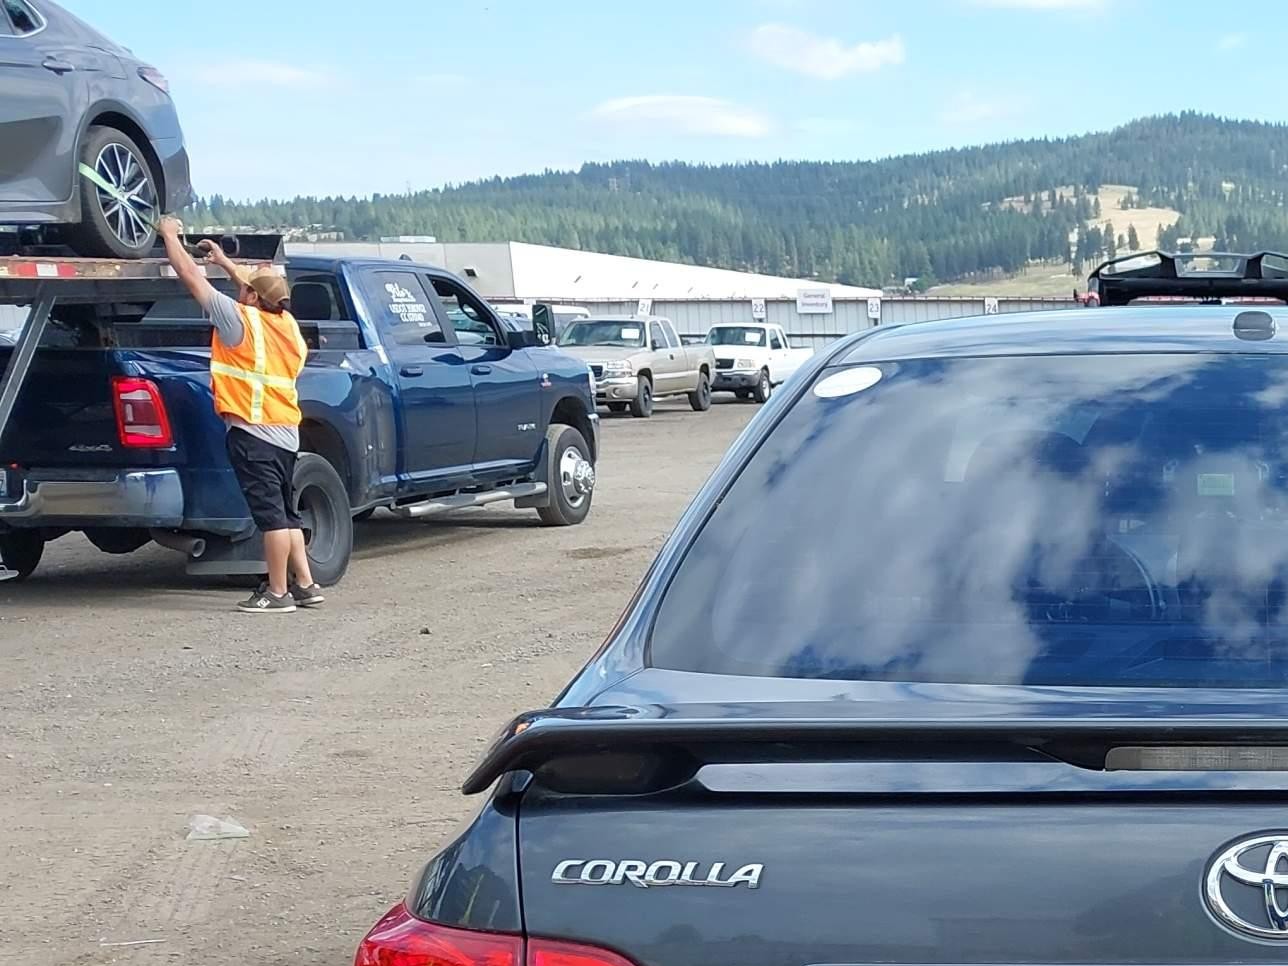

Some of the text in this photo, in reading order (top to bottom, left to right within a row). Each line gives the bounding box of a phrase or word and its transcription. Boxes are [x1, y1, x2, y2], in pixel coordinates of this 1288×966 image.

[640, 303, 649, 312] 21
[753, 304, 765, 313] 22
[869, 303, 879, 313] 23
[986, 304, 997, 314] 24
[551, 859, 764, 889] COROLLA
